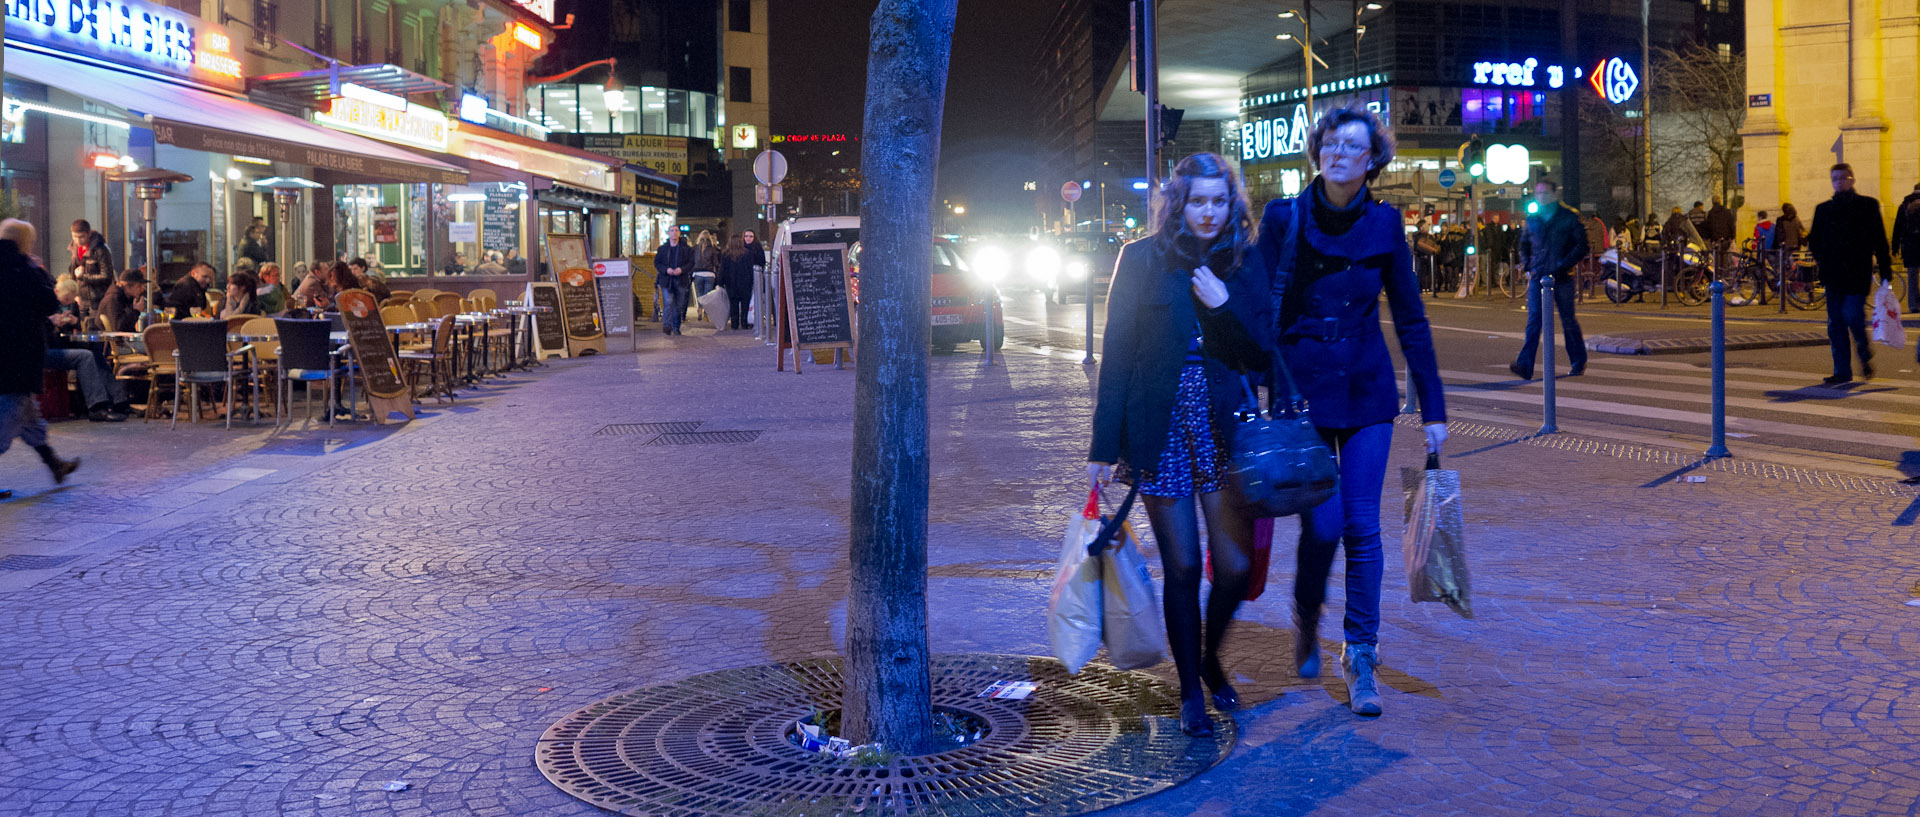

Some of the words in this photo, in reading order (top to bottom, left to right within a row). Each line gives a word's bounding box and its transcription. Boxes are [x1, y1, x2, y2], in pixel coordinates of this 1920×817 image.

[212, 33, 229, 51] BAR
[200, 51, 242, 78] BRASSERIE
[1242, 91, 1286, 107] CENTRE
[1293, 73, 1382, 99] COMMERCIAL
[153, 124, 175, 144] BAR
[202, 133, 223, 147] Service
[821, 134, 847, 142] PLAZA
[636, 138, 663, 147] LOUER
[306, 150, 329, 167] PALAIS
[329, 153, 338, 168] DE
[338, 154, 346, 169] LA
[623, 150, 651, 158] BUREAUX
[655, 161, 666, 172] 99
[672, 162, 682, 173] 00
